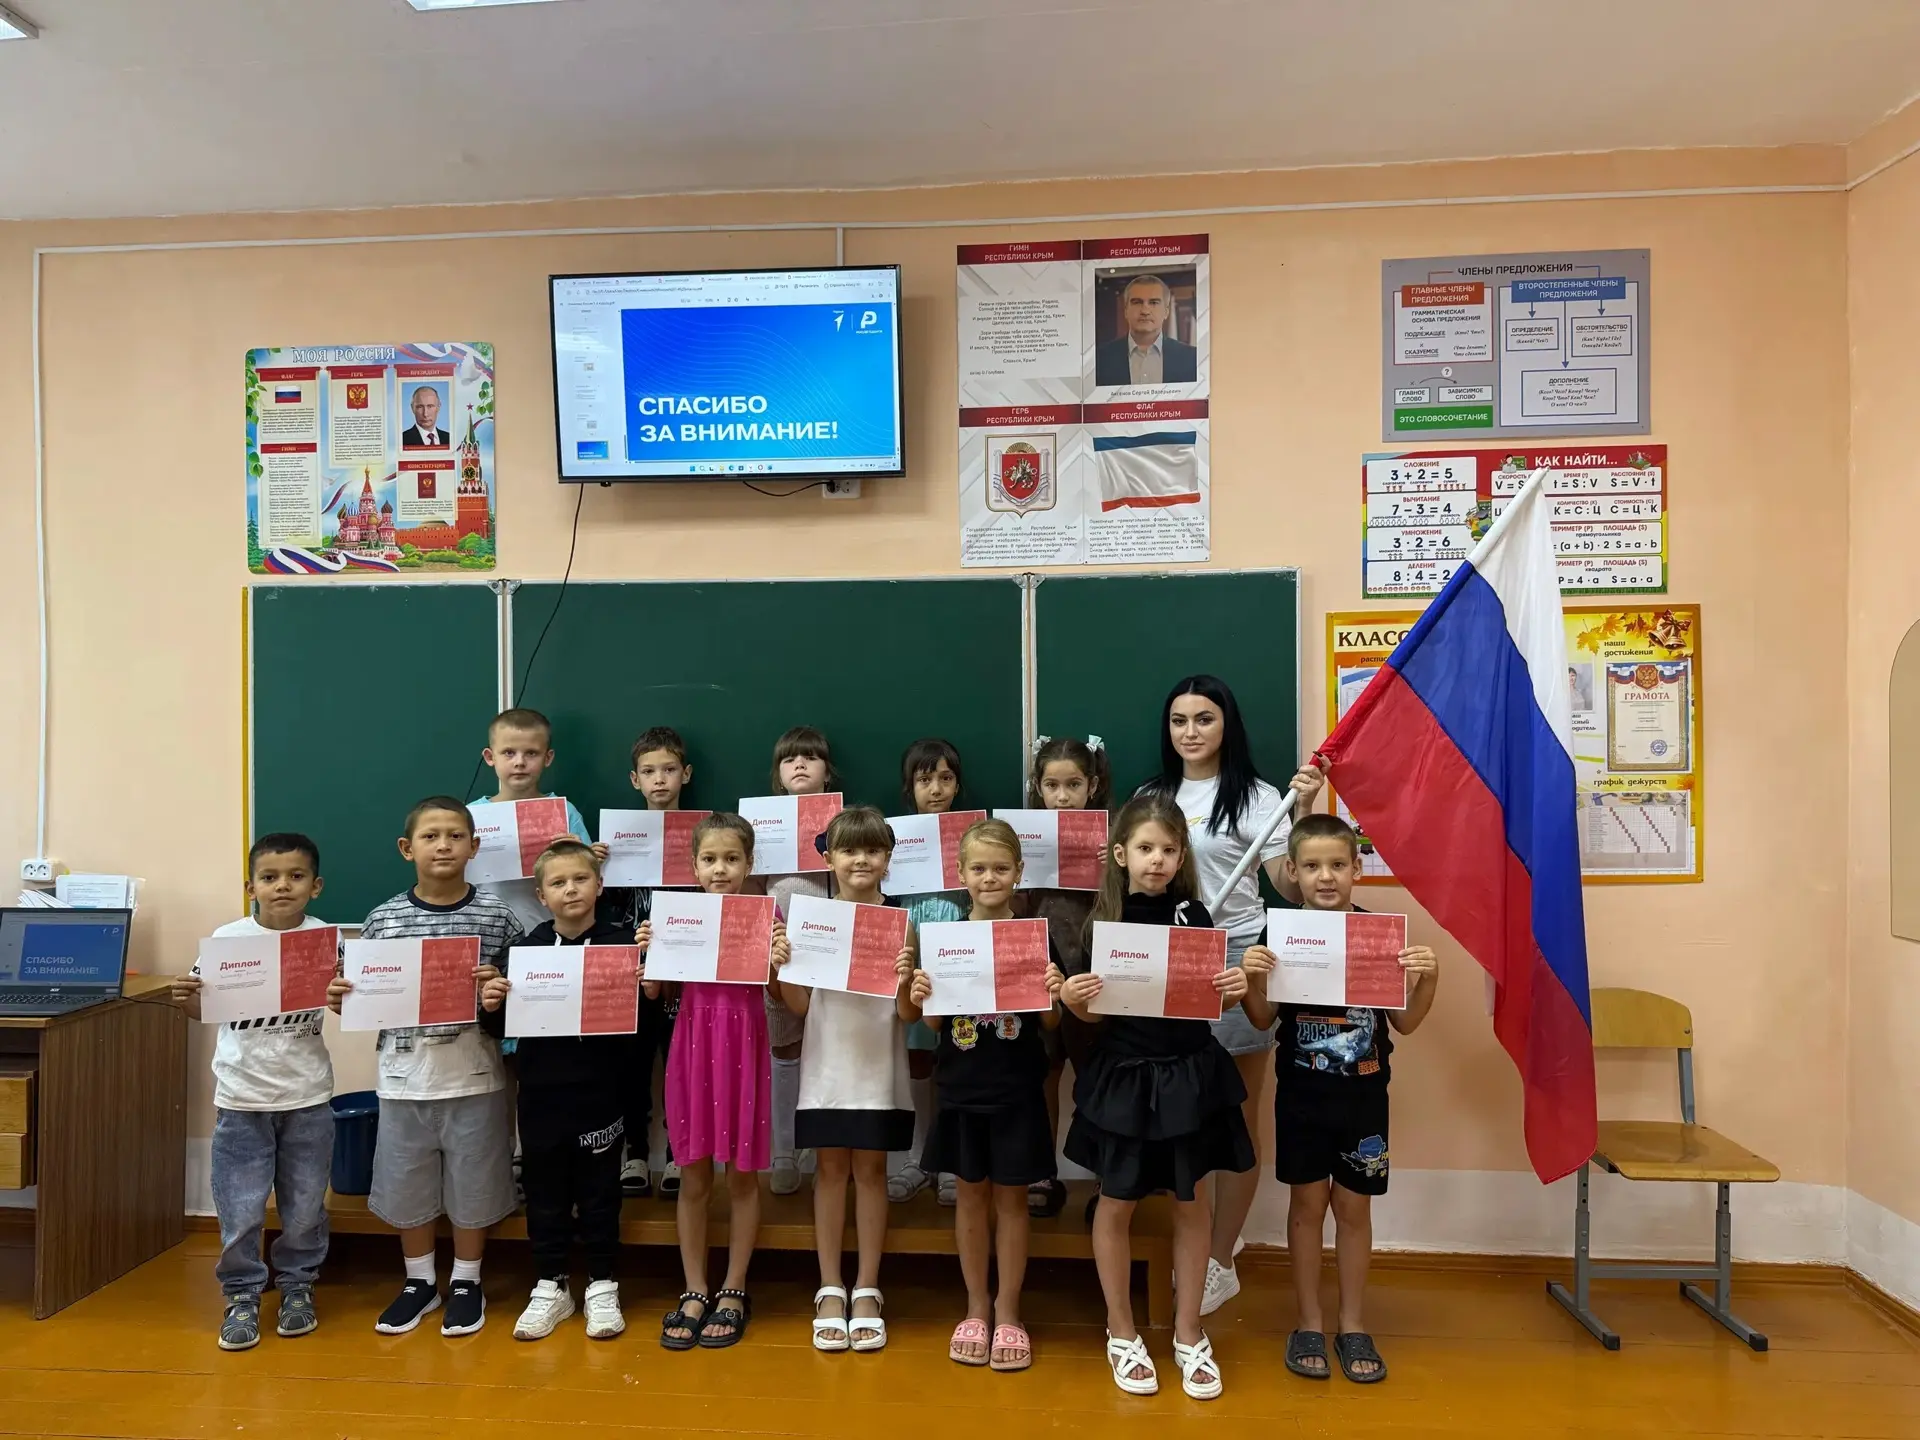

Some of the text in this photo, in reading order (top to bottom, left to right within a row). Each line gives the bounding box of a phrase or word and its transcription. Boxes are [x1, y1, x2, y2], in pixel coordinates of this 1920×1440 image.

[1111, 248, 1157, 256] РЕСПУБЛИКИ
[1458, 264, 1573, 276] ЧЛЕНЫ ПРЕДЛОЖЕНИЯ
[1518, 281, 1589, 289] ВТОРОСТЕПЕННЫЕ
[1411, 286, 1447, 294] ГЛАВНЫЕ
[1540, 290, 1597, 299] ПРЕДЛОЖЕНИЯ
[1411, 295, 1469, 304] ПРЕДЛОЖЕНИЯ
[293, 347, 396, 363] МОЯ РОССИЯ
[639, 395, 767, 415] СПАСИБО
[1416, 414, 1488, 422] СЛОВОСОЧЕТАНИЕ
[640, 421, 838, 442] ЗА ВНИМАНИЕ!
[1535, 453, 1617, 466] КАК НАЙТИ...
[1391, 468, 1452, 480] 3 2 5
[1495, 481, 1503, 489] V
[1554, 479, 1598, 488] t S V
[1611, 478, 1617, 487] S
[1632, 478, 1640, 486] V
[1392, 503, 1451, 515] 7 3 4
[1593, 505, 1601, 515] Ц
[1633, 505, 1640, 514] Ц
[1393, 536, 1450, 548] 3 2 6
[1604, 541, 1609, 549] 2
[1616, 541, 1621, 549] S
[1651, 540, 1657, 548] b
[1393, 570, 1450, 581] 8 4 2
[1577, 576, 1583, 584] 4
[1604, 649, 1653, 657] достижения
[1624, 692, 1670, 700] ГРАМОТА
[1594, 778, 1667, 787] график дежурств
[752, 818, 783, 826] Диплом
[475, 826, 500, 834] иплом
[614, 831, 648, 840] Диплом
[666, 916, 703, 925] Диплом
[801, 921, 836, 933] Диплом
[1285, 936, 1326, 946] Диплом
[938, 948, 975, 957] Диплом
[1110, 950, 1149, 959] Диплом
[26, 956, 74, 964] СПАСИБО
[220, 960, 261, 971] Диплом
[361, 965, 402, 974] Диплом
[39, 967, 99, 975] ВНИМАНИЕ!
[526, 972, 564, 980] Диплом
